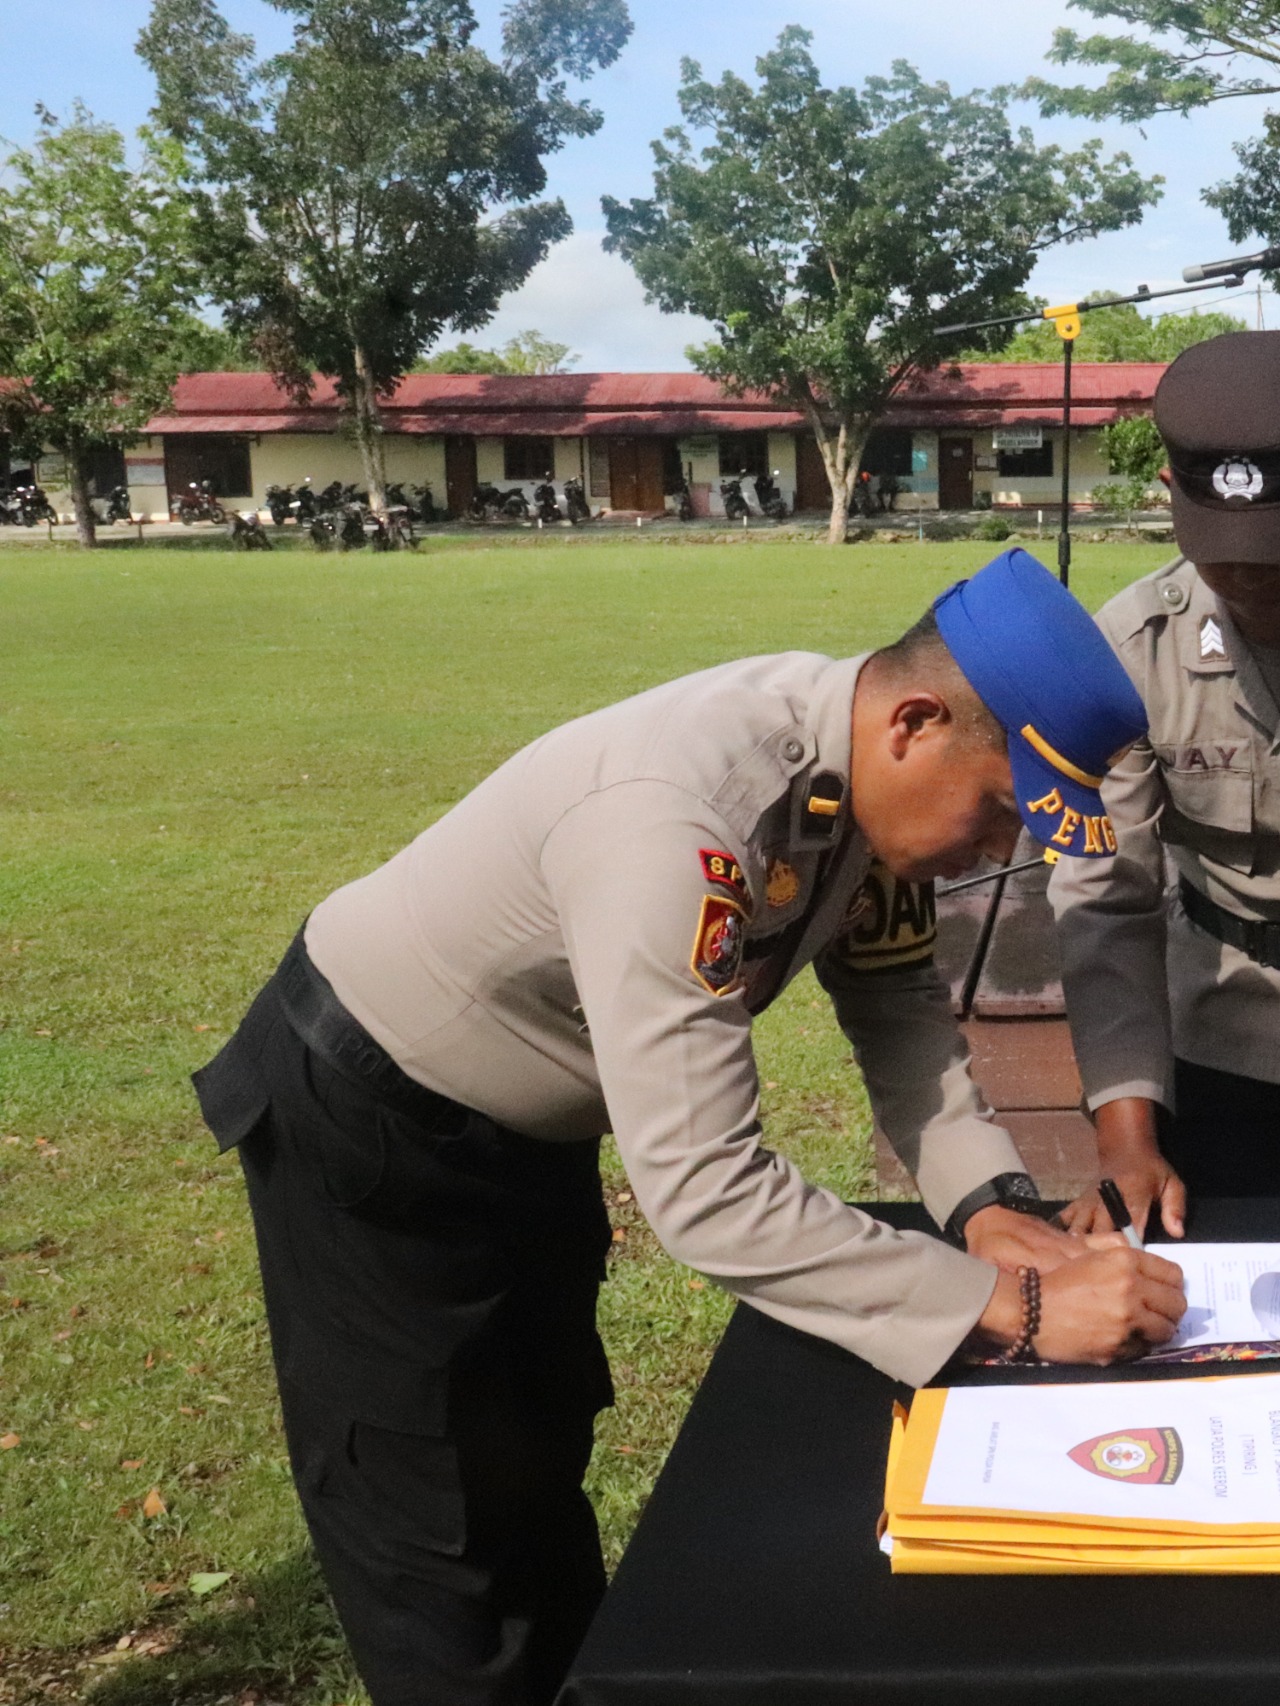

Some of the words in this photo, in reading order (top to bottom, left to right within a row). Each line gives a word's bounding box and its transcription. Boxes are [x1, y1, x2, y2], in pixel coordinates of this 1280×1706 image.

[1209, 1416, 1224, 1436] LATJA
[1211, 1436, 1226, 1465] POLRES
[1213, 1466, 1229, 1498] KEEROM
